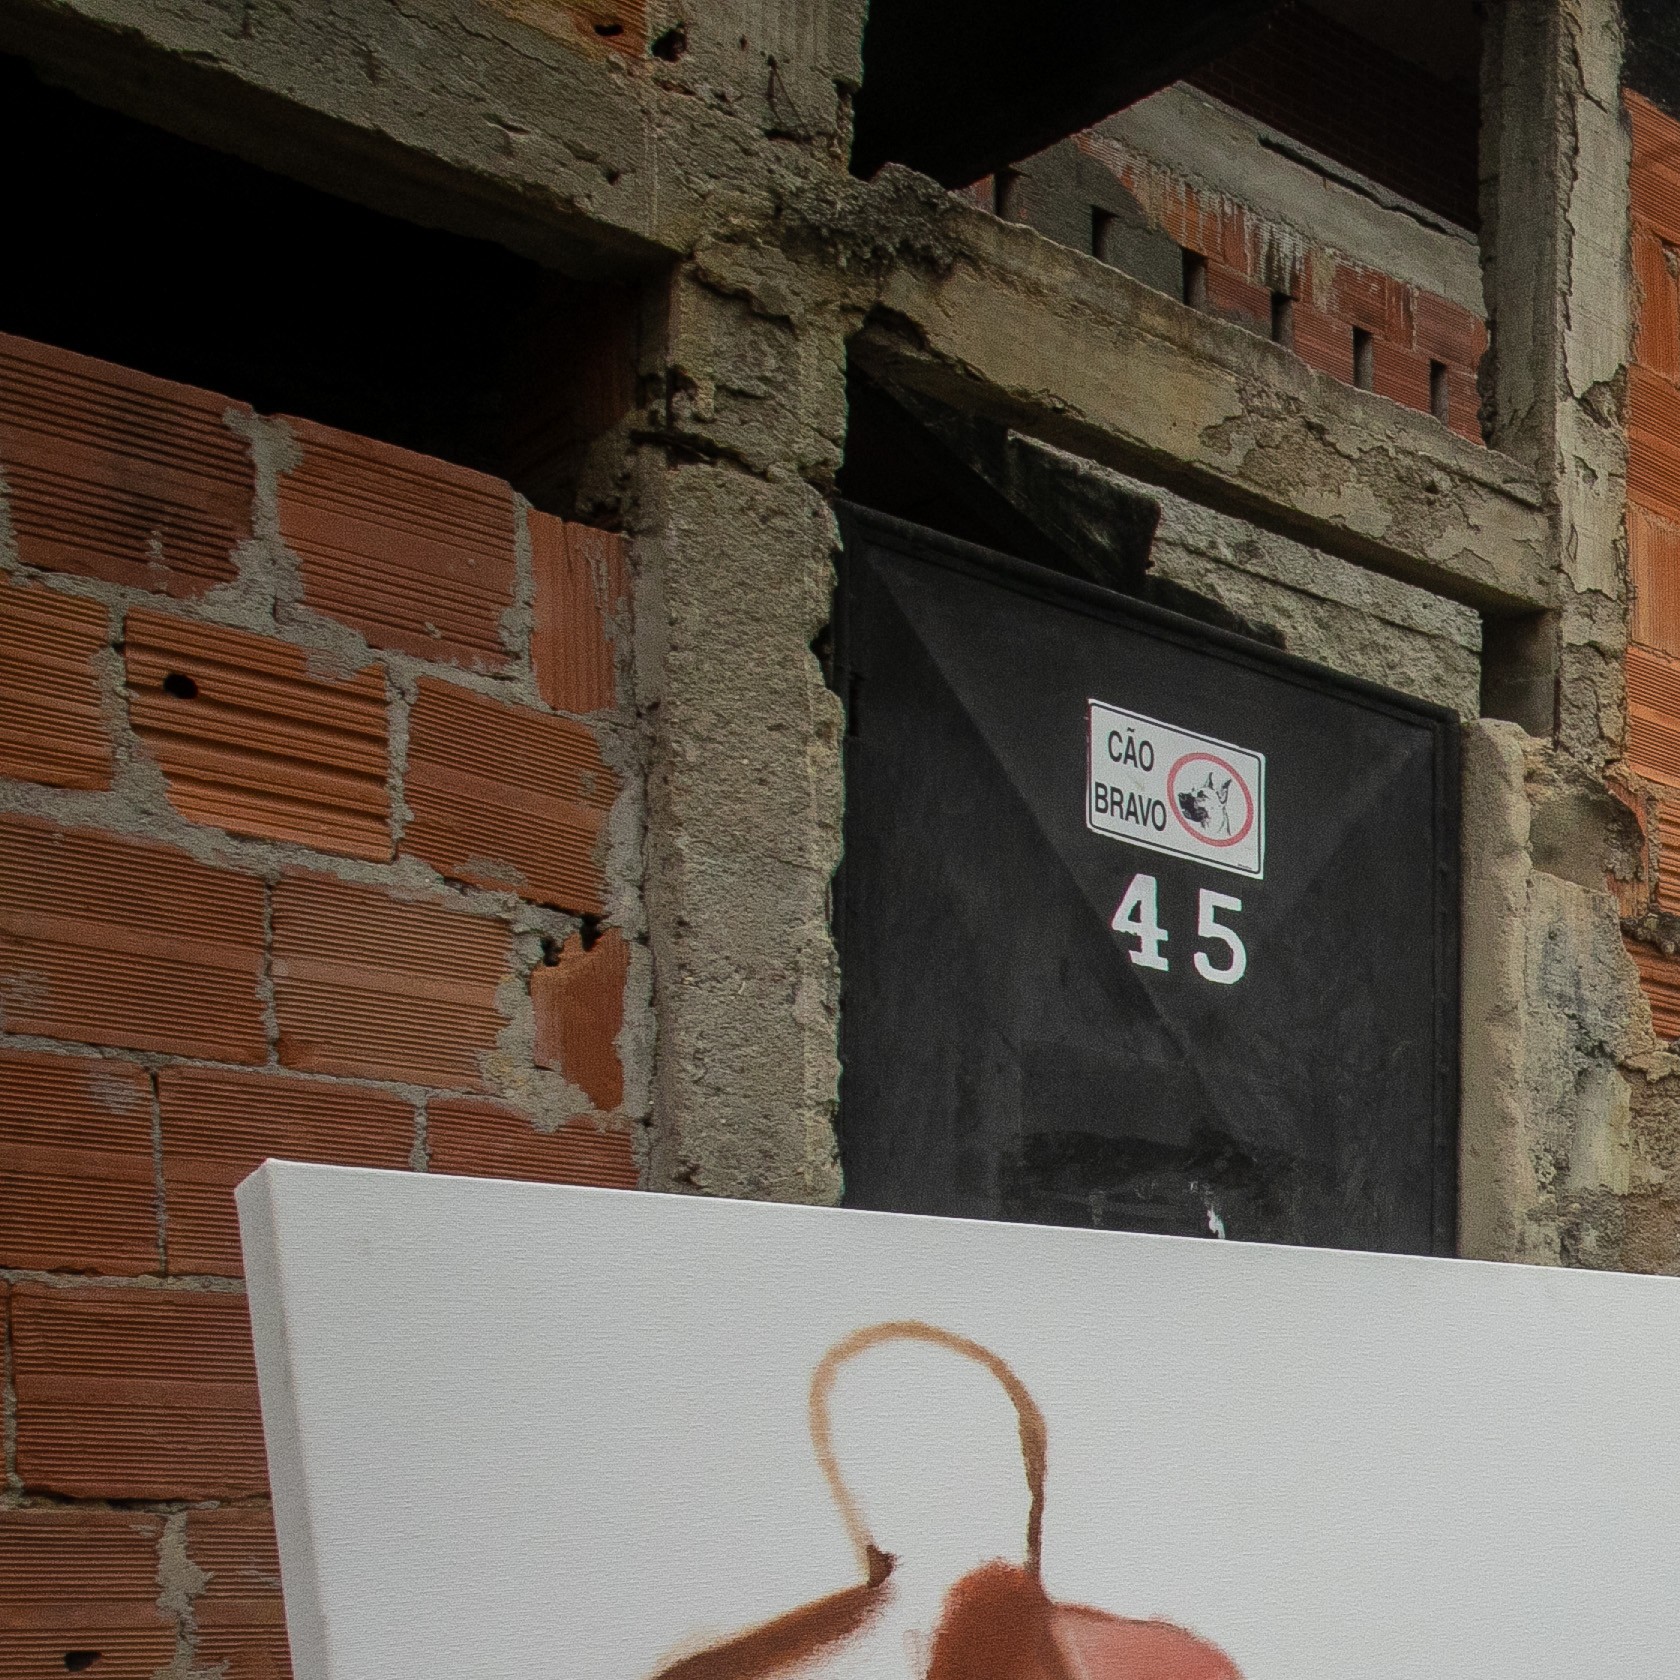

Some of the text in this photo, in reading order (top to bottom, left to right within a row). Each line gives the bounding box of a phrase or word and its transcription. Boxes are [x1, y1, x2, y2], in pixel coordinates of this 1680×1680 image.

[1108, 728, 1154, 772] CÃO
[1094, 782, 1167, 831] BRAVO
[1112, 873, 1246, 985] 45
